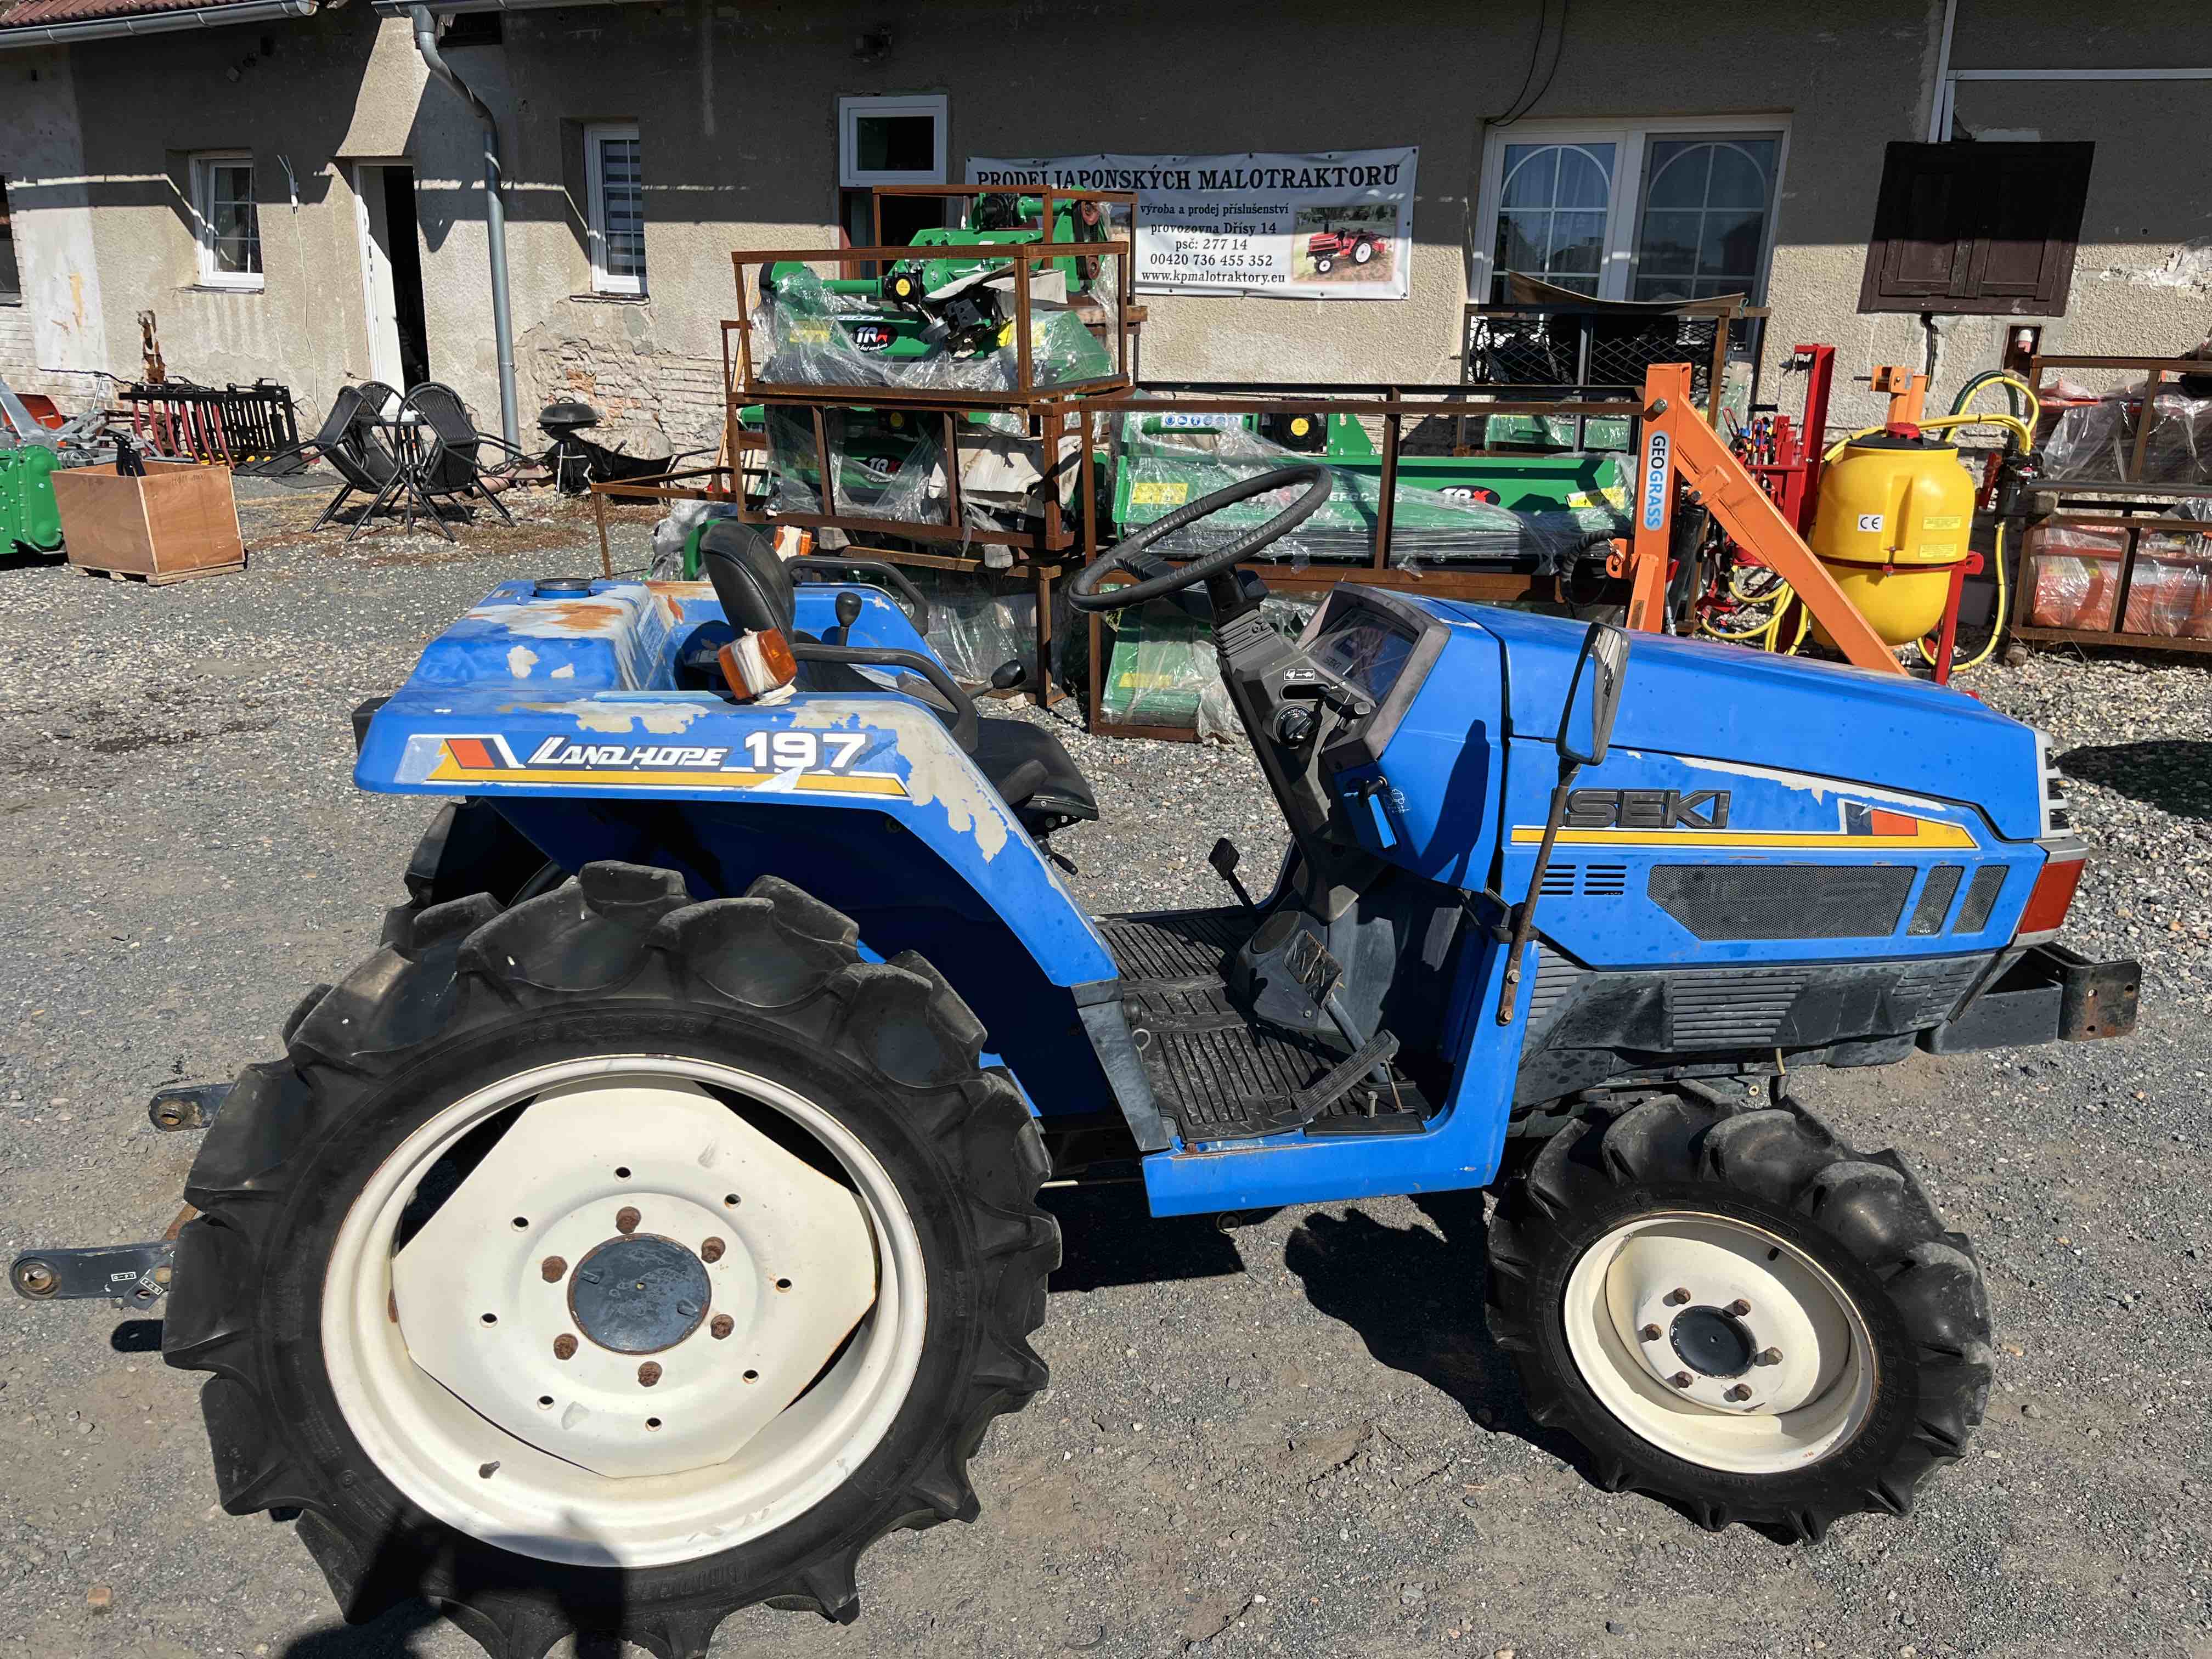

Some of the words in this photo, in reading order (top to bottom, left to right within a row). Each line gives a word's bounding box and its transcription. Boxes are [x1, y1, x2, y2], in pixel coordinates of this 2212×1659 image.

[1054, 164, 1192, 190] JAPONSKÝCH
[1198, 163, 1400, 190] MALOTRAKTORŮ
[1141, 203, 1175, 215] výroba
[1188, 204, 1219, 217] prodej
[1222, 202, 1289, 216] příslušenství
[1150, 223, 1220, 235] provozovna
[1223, 222, 1256, 236] Dřísy
[1261, 222, 1277, 234] 14
[1175, 238, 1198, 252] psč:
[1203, 238, 1228, 250] 277
[1232, 238, 1248, 250] 14
[1150, 253, 1189, 265] 00420
[1193, 254, 1216, 266] 736
[1220, 255, 1244, 266] 455
[1248, 255, 1273, 267] 352
[1141, 270, 1285, 285] www.kpmalotraktory.eu
[1646, 435, 1666, 527] GEOGRASS
[744, 731, 866, 768] 197
